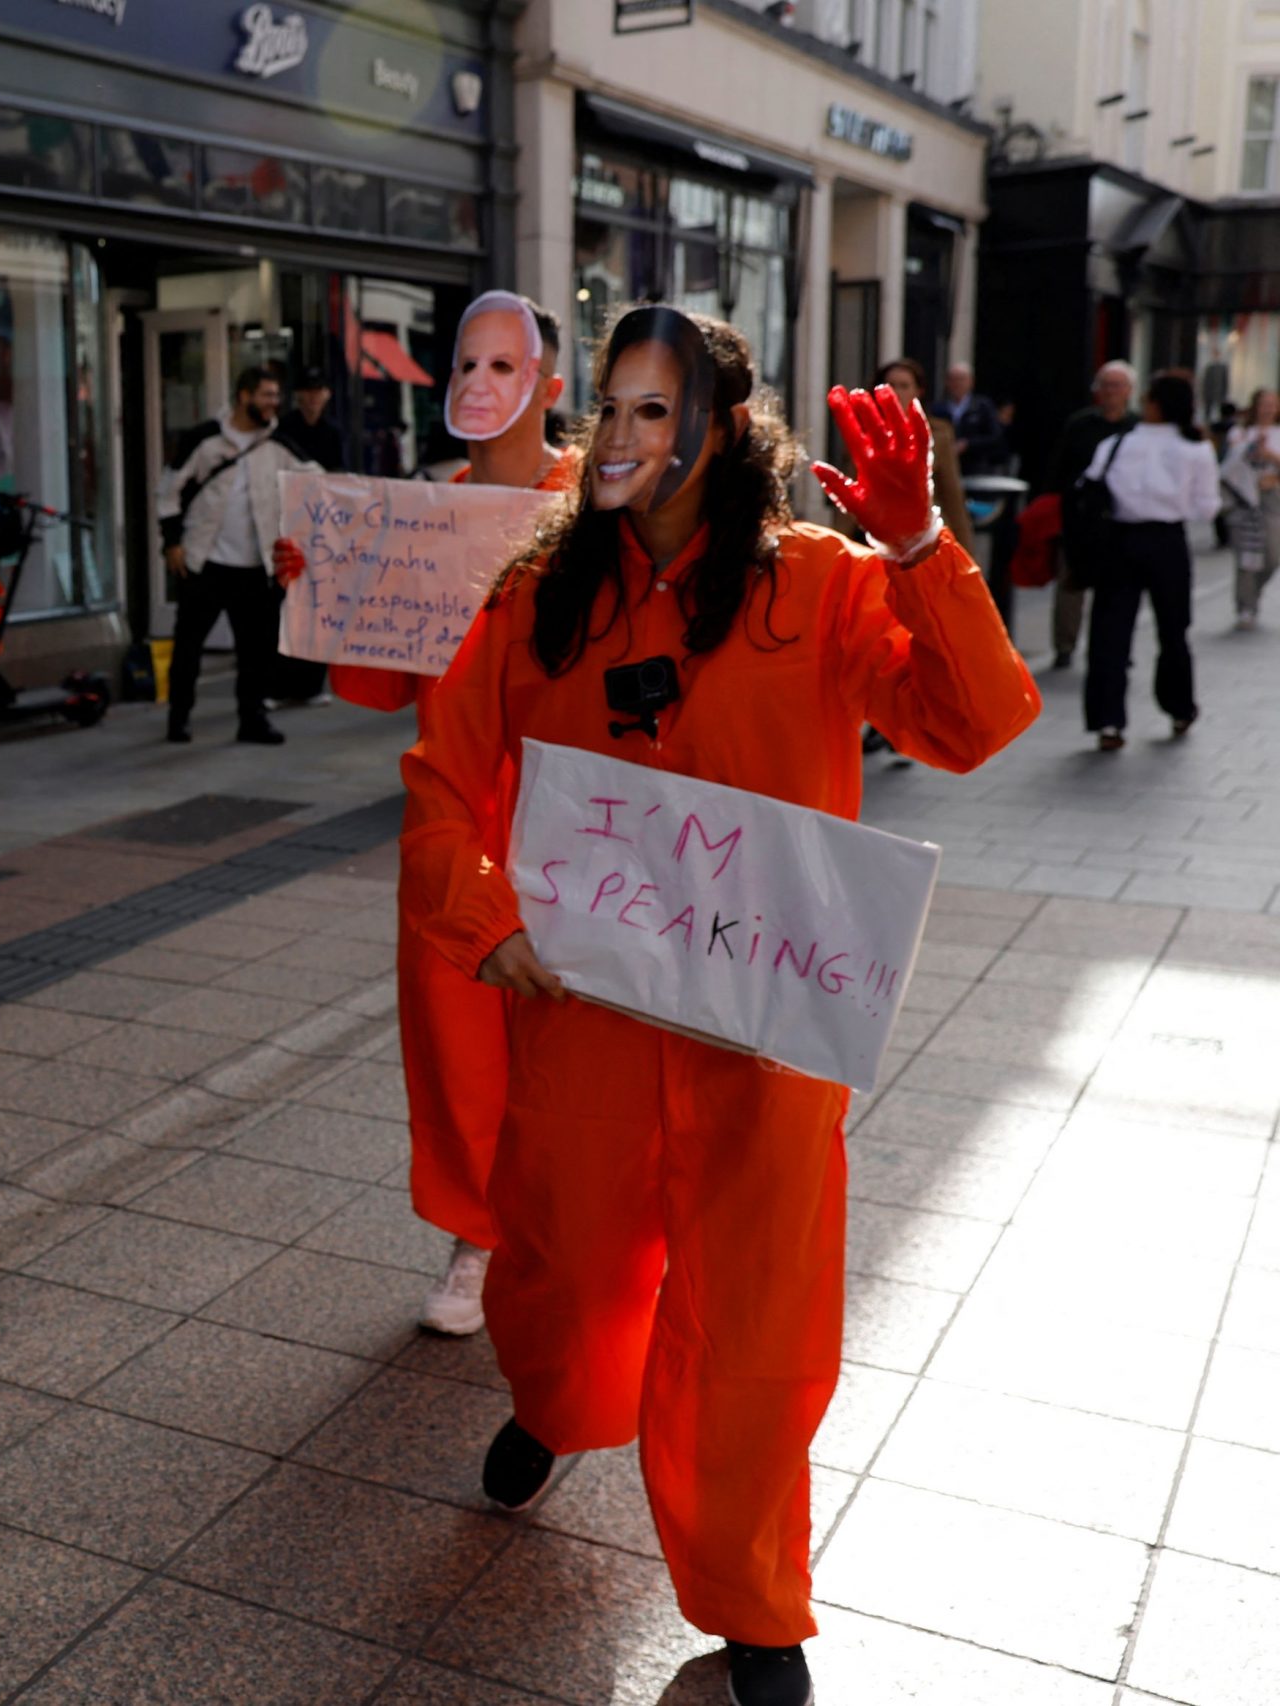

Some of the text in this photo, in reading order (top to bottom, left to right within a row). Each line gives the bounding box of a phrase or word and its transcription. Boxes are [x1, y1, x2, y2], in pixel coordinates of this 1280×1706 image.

[304, 501, 352, 526] War
[358, 592, 472, 620] responsible
[355, 617, 398, 635] death
[404, 616, 428, 654] of
